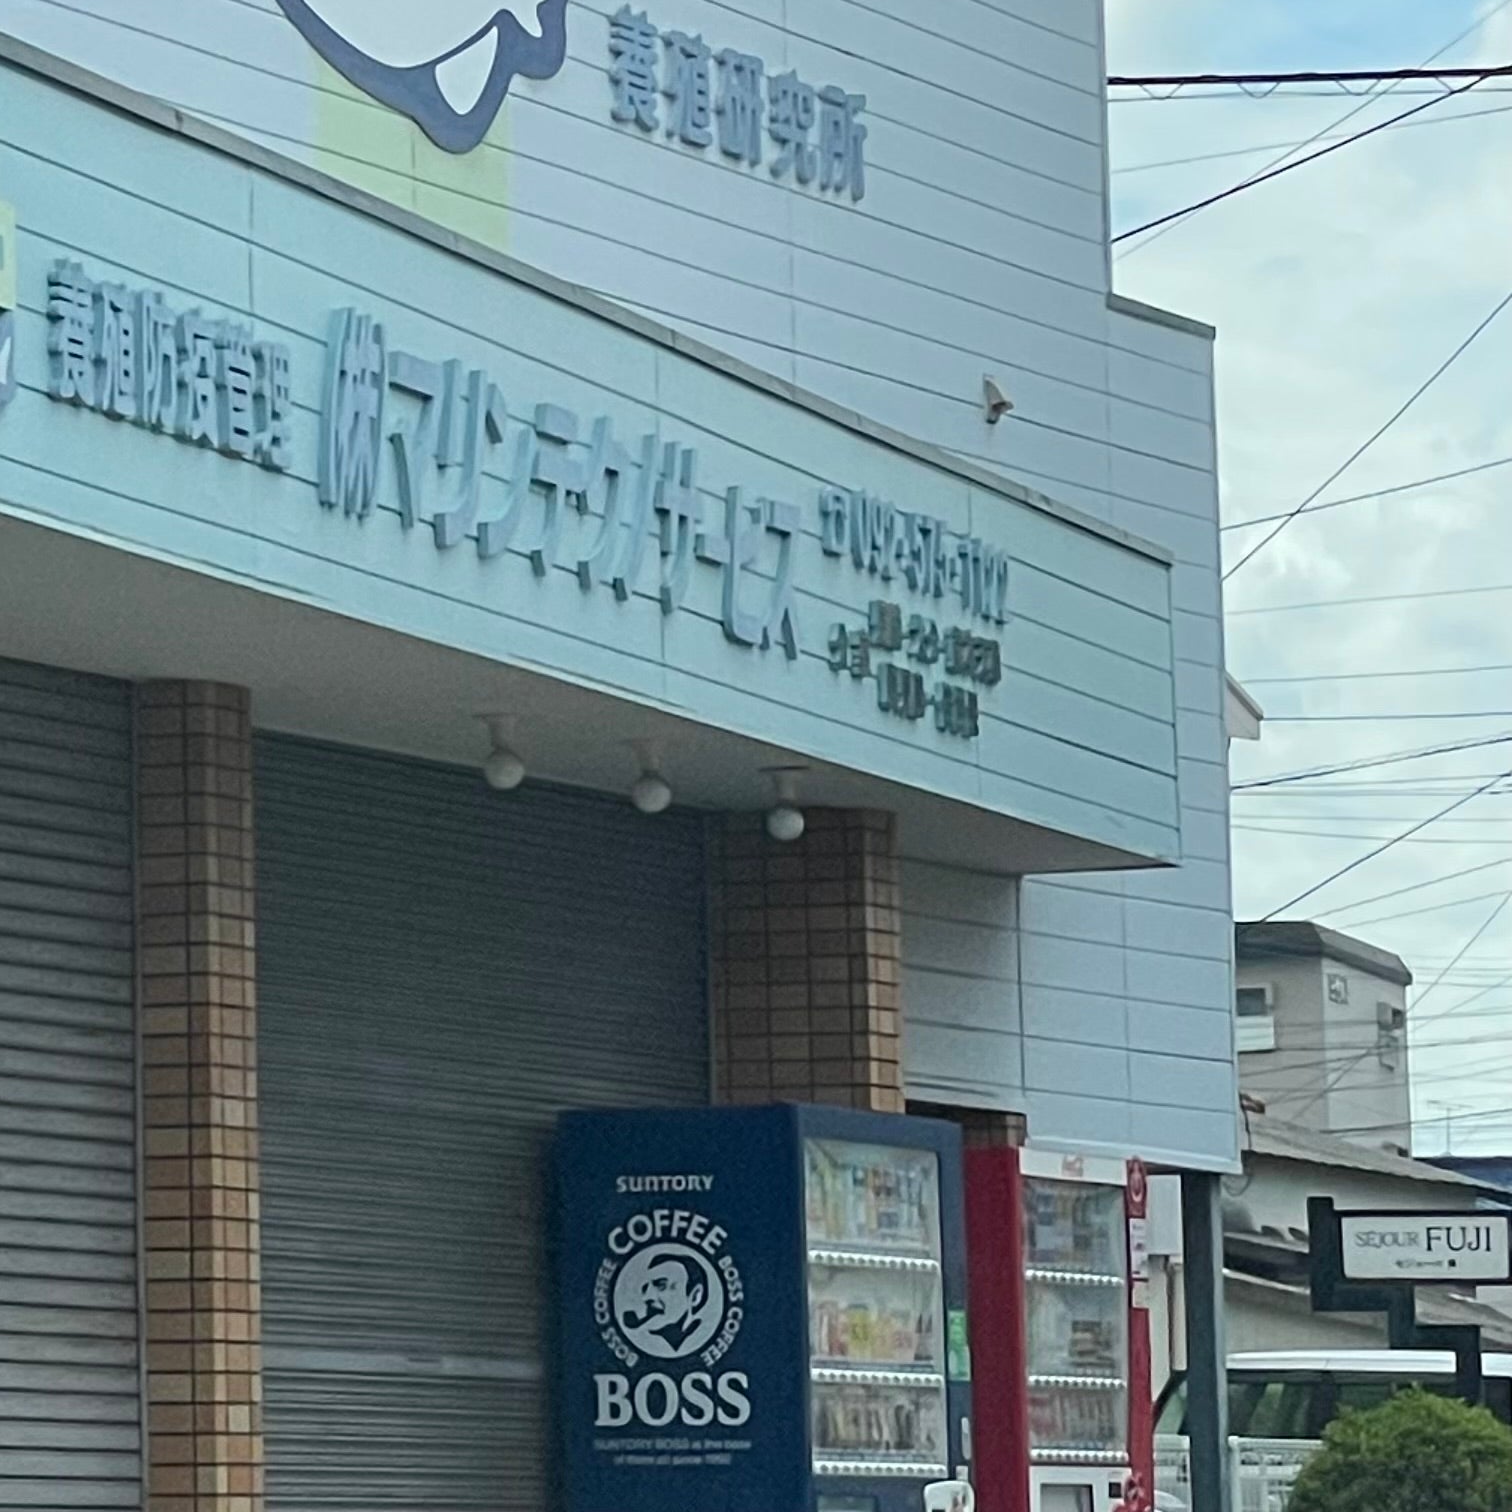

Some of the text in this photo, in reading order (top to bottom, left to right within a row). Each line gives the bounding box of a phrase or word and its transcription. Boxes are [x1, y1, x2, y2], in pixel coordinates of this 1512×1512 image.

[604, 2, 866, 203] 養殖研究所
[615, 1175, 714, 1193] SUNTORY
[607, 1208, 728, 1255] COFFEE
[1426, 1226, 1491, 1252] FUJI
[593, 1257, 618, 1325] COFFEE
[700, 1255, 744, 1367] BOSS COFFEE
[593, 1371, 751, 1427] BOSS
